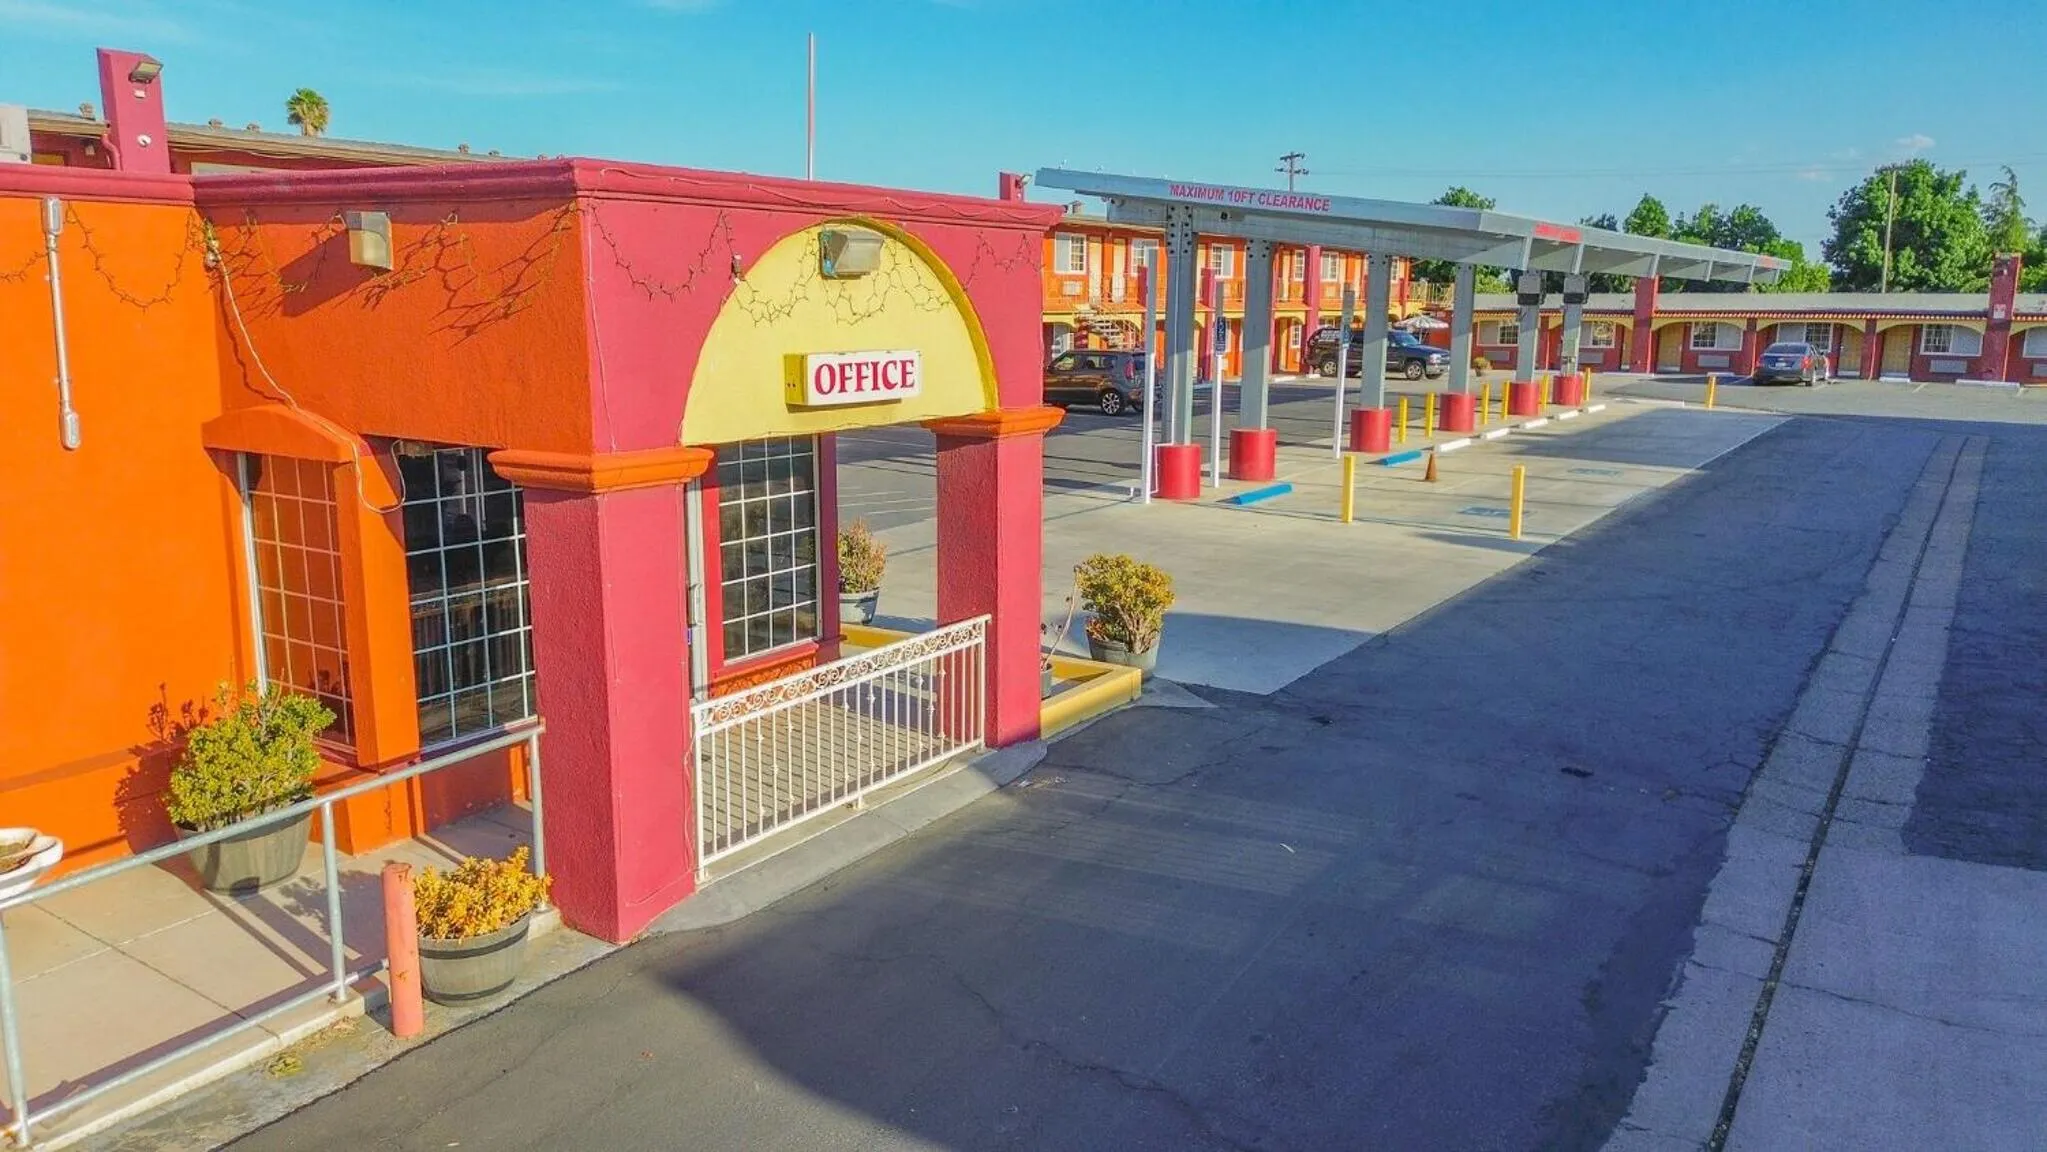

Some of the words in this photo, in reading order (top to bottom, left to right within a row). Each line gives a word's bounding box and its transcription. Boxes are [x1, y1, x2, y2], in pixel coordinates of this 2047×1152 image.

[1169, 184, 1224, 200] MAXIMUM
[1228, 190, 1256, 204] 10FT
[1258, 193, 1331, 211] CLEARANCE
[814, 359, 915, 395] OFFICE
